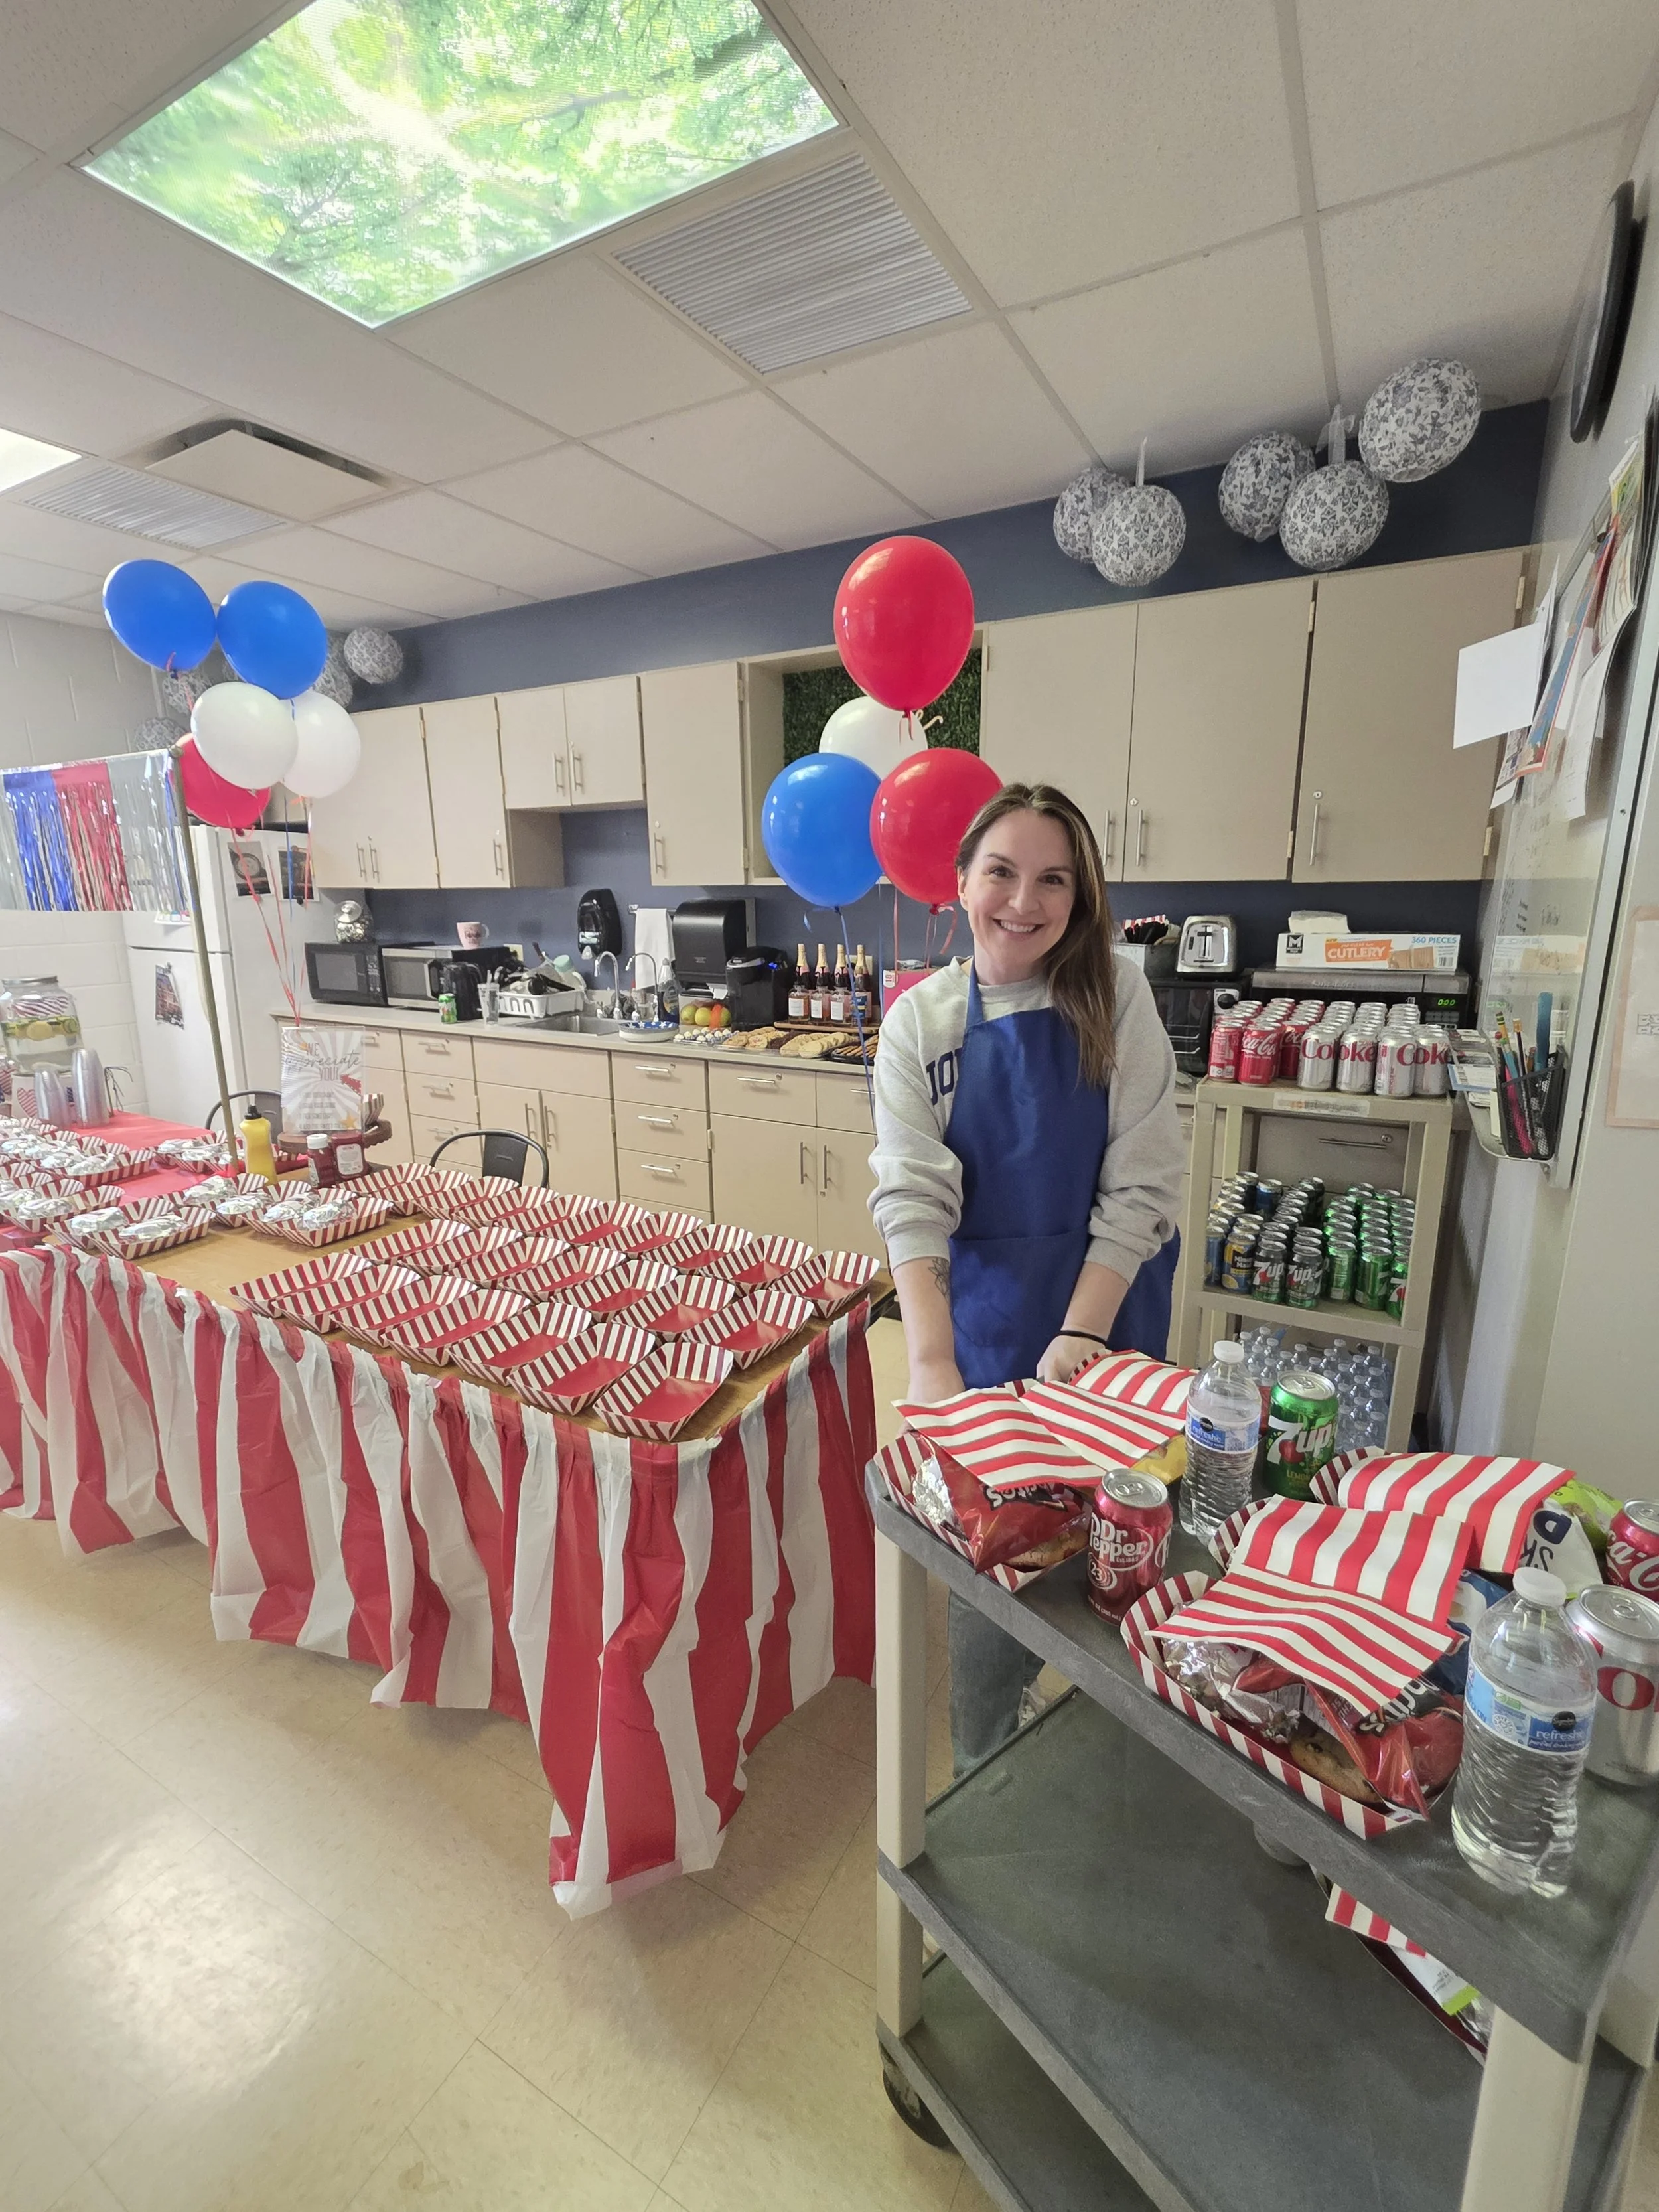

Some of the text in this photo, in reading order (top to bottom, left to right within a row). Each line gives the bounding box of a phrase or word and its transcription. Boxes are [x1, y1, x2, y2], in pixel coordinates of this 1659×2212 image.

[1327, 946, 1386, 959] CUTLERY
[1267, 1414, 1333, 1465] 7up
[1089, 1512, 1149, 1562] Pepper
[1101, 1519, 1128, 1544] Dr
[1091, 1561, 1104, 1582] 23
